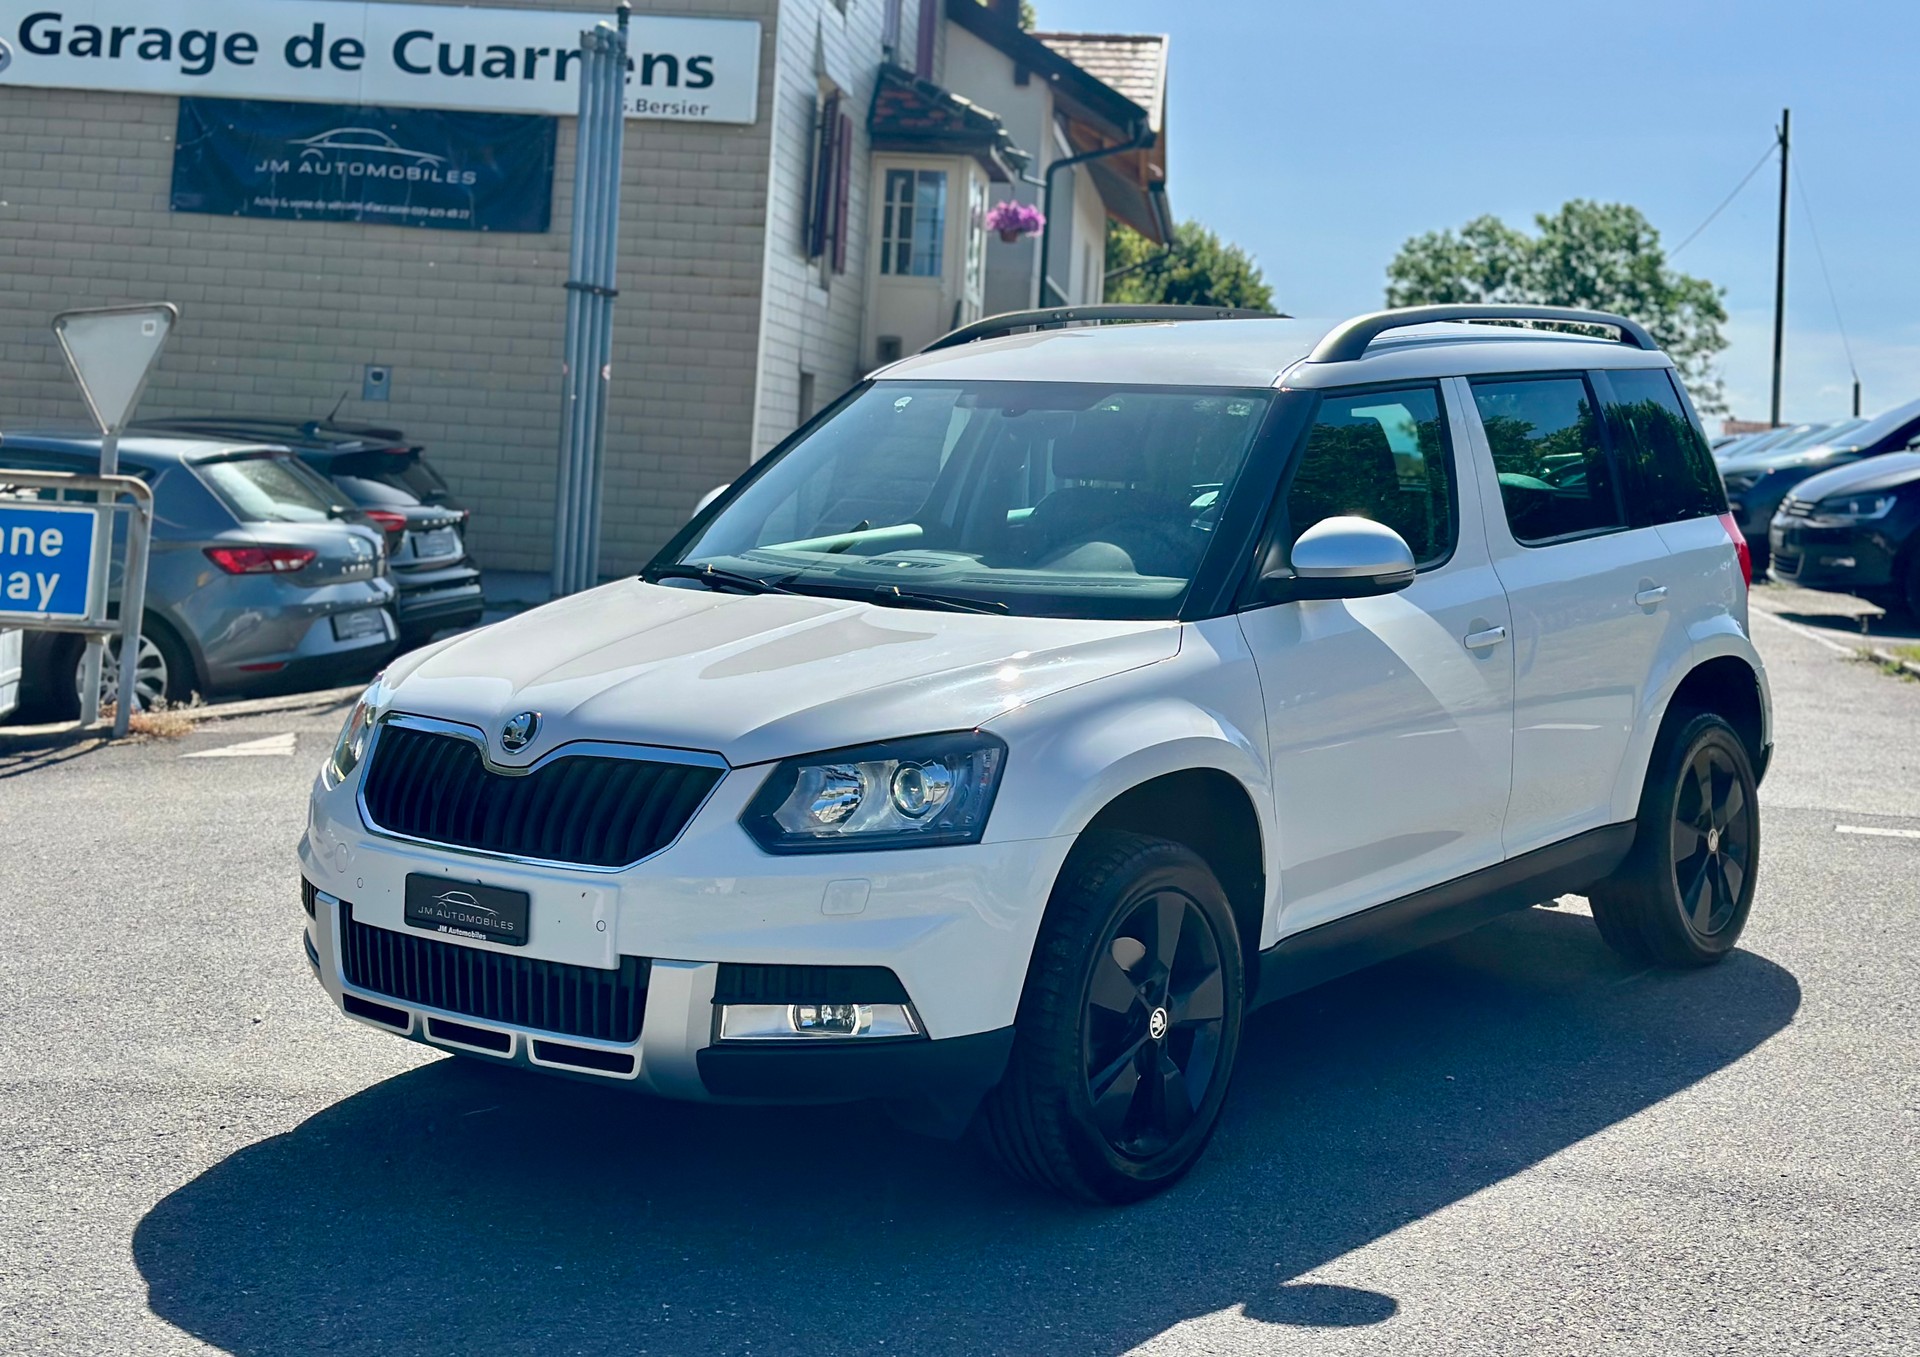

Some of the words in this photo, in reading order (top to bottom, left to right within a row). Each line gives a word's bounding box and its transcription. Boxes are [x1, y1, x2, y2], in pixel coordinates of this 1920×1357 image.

[18, 12, 259, 75] Garage
[284, 22, 365, 71] de
[392, 30, 715, 89] Cuarnns
[255, 160, 289, 172] JM
[298, 161, 477, 185] AUTOMOBILES
[0, 526, 64, 557] ne
[0, 571, 61, 611] ay
[418, 906, 433, 915] JM
[436, 909, 515, 931] AUTOMOBILES
[437, 924, 448, 933] JM
[448, 926, 487, 940] Automobiles
